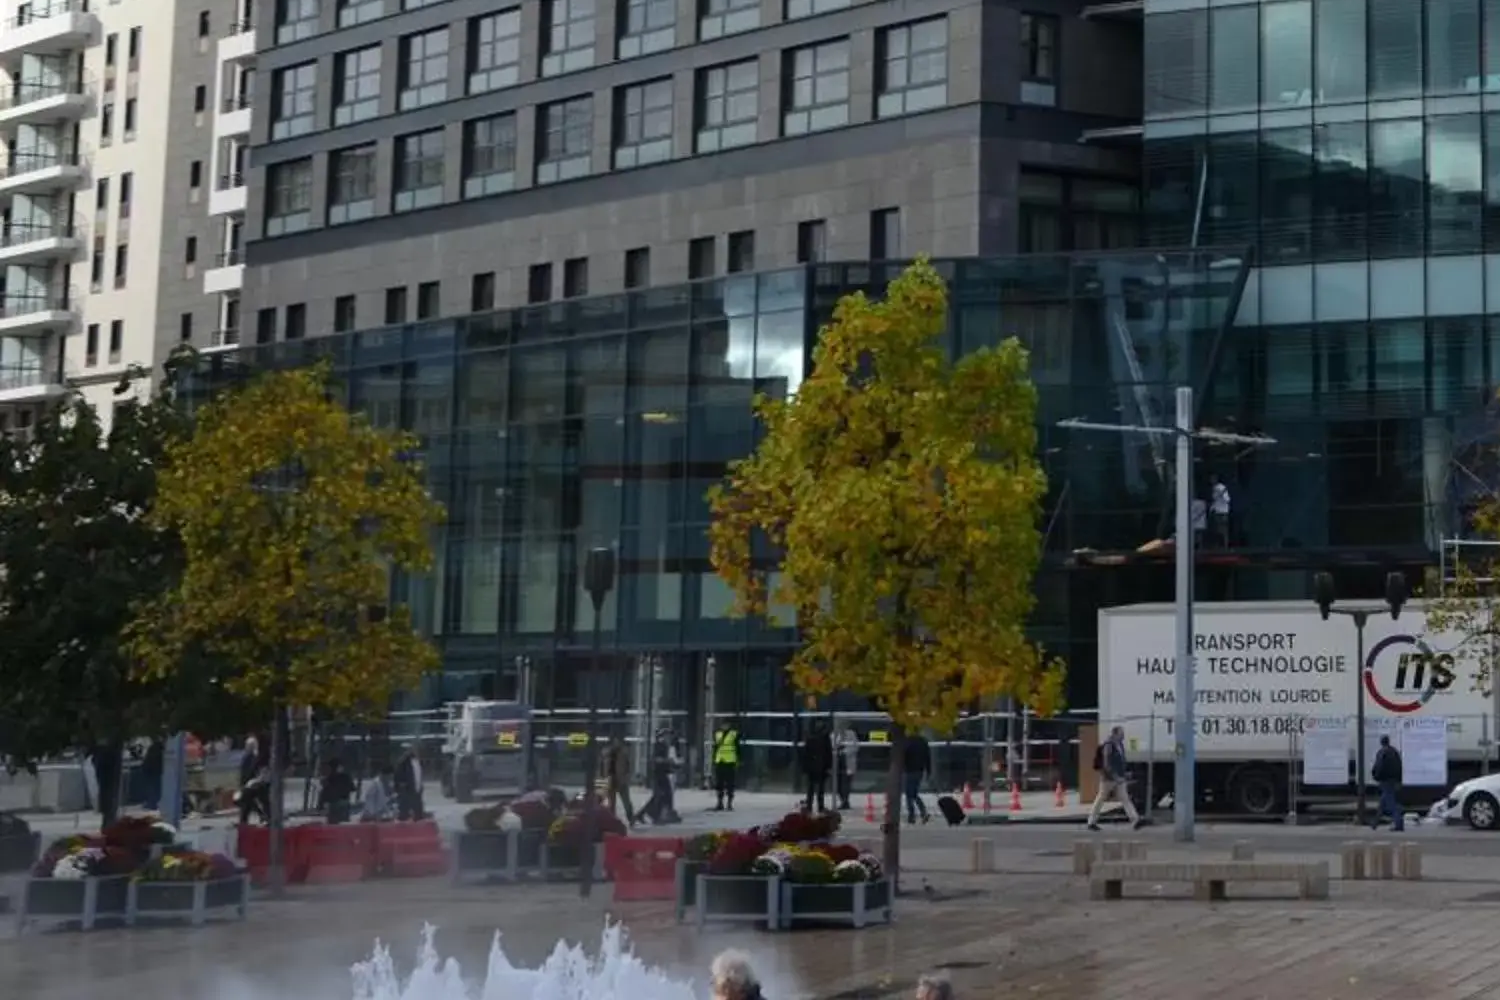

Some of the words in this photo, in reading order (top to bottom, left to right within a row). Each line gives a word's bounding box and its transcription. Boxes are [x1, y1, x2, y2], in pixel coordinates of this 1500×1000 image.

[1193, 633, 1297, 650] RANSPORT
[1137, 657, 1199, 675] HAUE
[1208, 655, 1346, 674] TECHNOLOGIE
[1395, 653, 1457, 690] ITS
[1154, 690, 1261, 704] MATENTION
[1271, 688, 1332, 703] LOURDE
